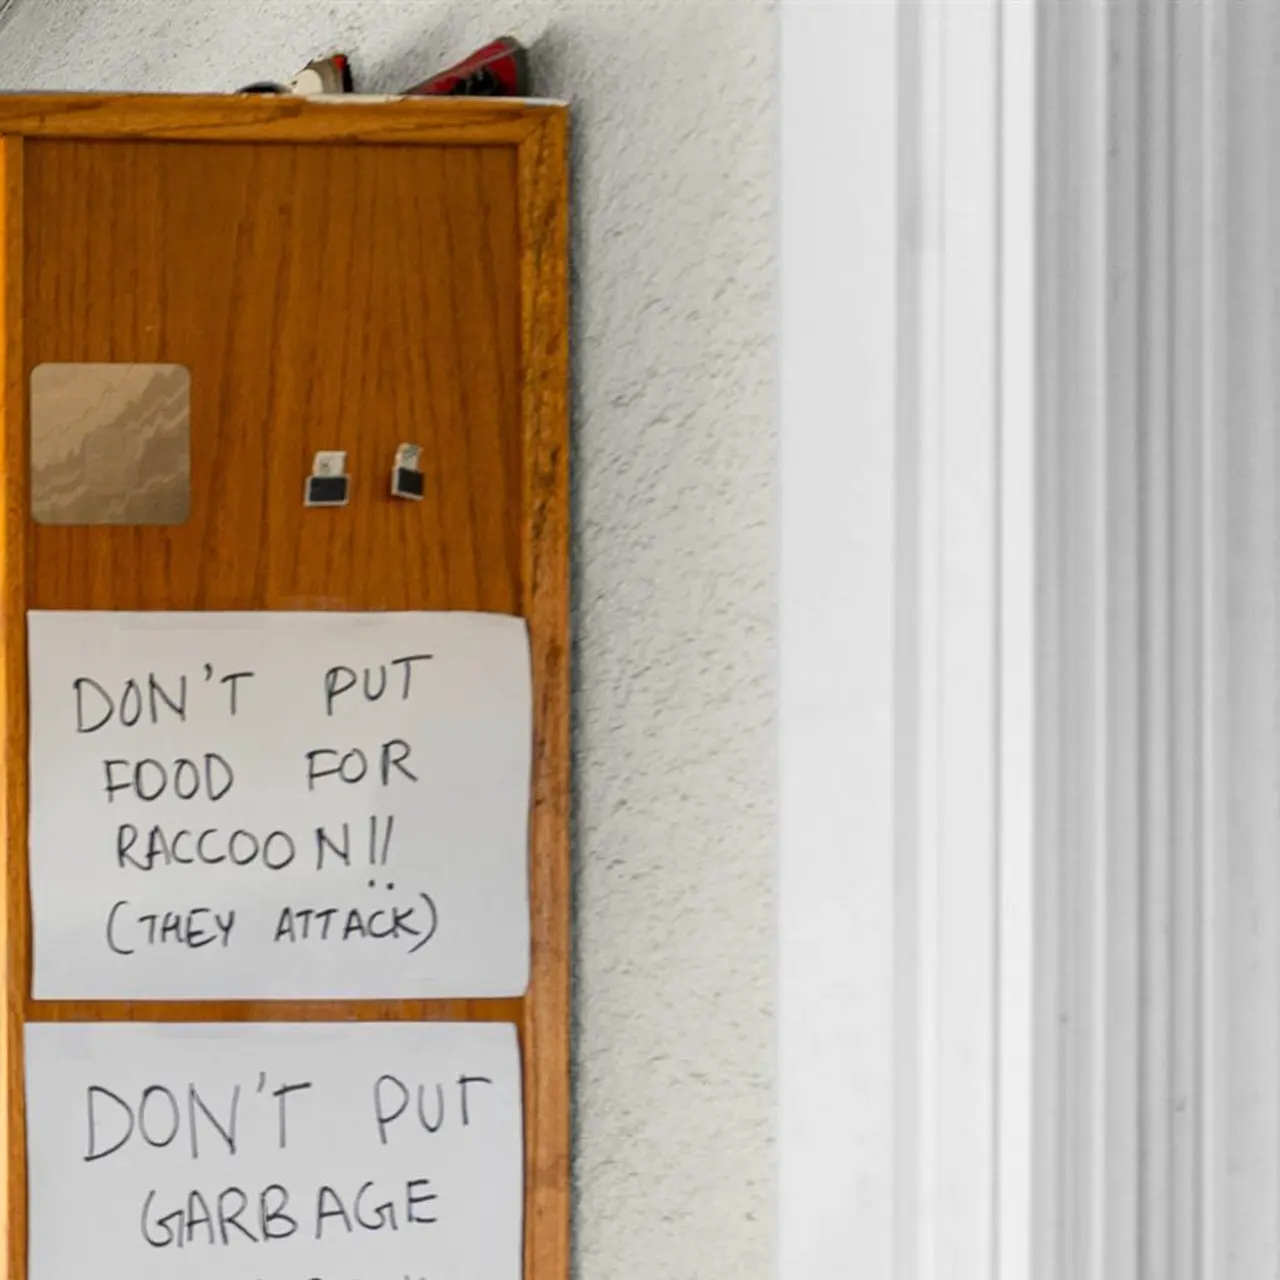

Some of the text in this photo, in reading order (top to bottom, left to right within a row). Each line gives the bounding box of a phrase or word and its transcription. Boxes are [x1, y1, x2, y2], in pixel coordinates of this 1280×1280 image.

[72, 653, 434, 734] DON'T PUT
[103, 738, 419, 803] FOOD FOR
[116, 814, 395, 891] RACCOON!!
[106, 892, 438, 956] (THEY ATTACK)
[82, 1071, 493, 1163] DON'T PUT
[141, 1178, 438, 1249] GARBAGE
